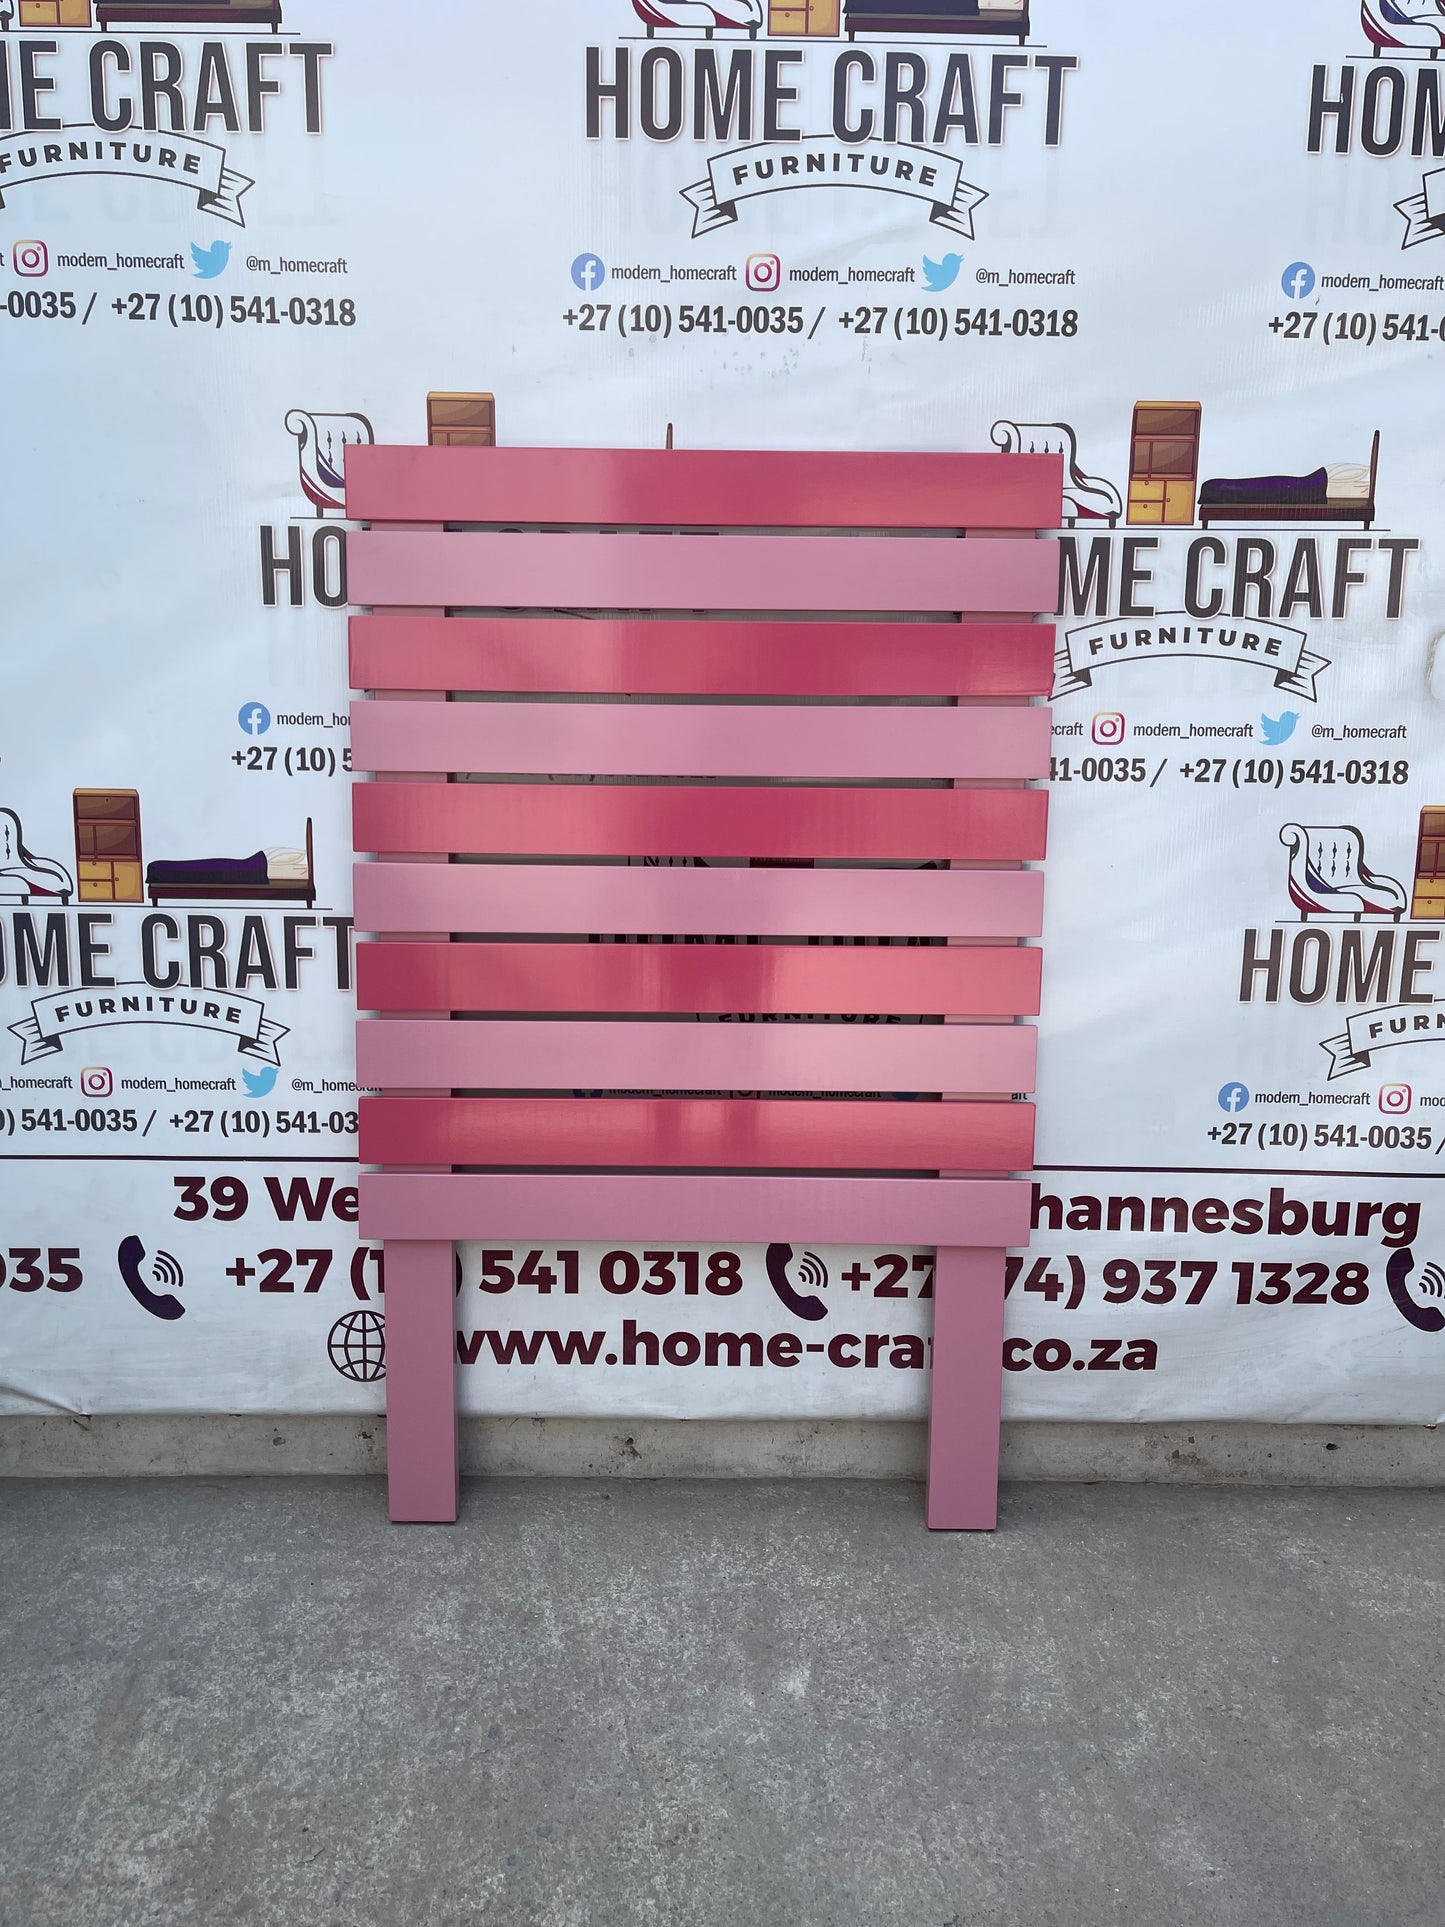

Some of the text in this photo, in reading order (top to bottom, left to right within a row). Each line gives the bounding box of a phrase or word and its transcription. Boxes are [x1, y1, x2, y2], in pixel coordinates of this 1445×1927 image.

[0, 40, 333, 133] E CRAFT
[585, 45, 1077, 146] HOME CRAFT
[0, 141, 201, 174] FURNITURE
[732, 152, 938, 187] FURNITURE
[57, 252, 348, 275] modern_homecraft @m_homecraft
[611, 264, 737, 283] modern_homecraft
[789, 266, 916, 285] modern_homecraft
[975, 268, 1076, 287] @m_homecraft
[1321, 273, 1445, 292] modern_homecraft
[111, 292, 161, 321] +27
[168, 293, 224, 329] (10)
[230, 295, 357, 327] 541-0318
[562, 303, 612, 331] +27
[618, 304, 672, 339] (10)
[678, 304, 804, 334] 541-0035
[838, 306, 888, 334] +27
[893, 307, 948, 342] (10)
[954, 308, 1079, 338] 541-0318
[1268, 311, 1318, 339] +27
[1323, 312, 1377, 347] (10)
[1184, 536, 1420, 619] CRAFT
[1088, 626, 1283, 656] FURNITURE
[1133, 723, 1408, 741] modern_homecraft @m_homecraft
[231, 746, 278, 771] +27
[284, 746, 336, 778] (10)
[1179, 758, 1227, 783] +27
[1232, 758, 1284, 789] (10)
[1289, 759, 1409, 785] 541-0318
[0, 911, 354, 990] ME CRAFT
[1239, 928, 1441, 1005] HOME
[54, 995, 243, 1024] FURNITURE
[121, 1076, 237, 1093] modern_homecraft
[291, 1078, 382, 1094] @m_home
[1254, 1090, 1371, 1107] modern_homecraft
[21, 1108, 138, 1132] 541-0035
[169, 1109, 214, 1133] +27
[220, 1110, 270, 1139] (10)
[1207, 1122, 1253, 1145] +27
[1257, 1123, 1308, 1152] (10)
[1313, 1124, 1432, 1150] 541-0035
[173, 1175, 249, 1222] 39
[0, 1247, 83, 1293] 35
[225, 1248, 333, 1294] +27
[478, 1249, 579, 1295] 541
[599, 1250, 743, 1296] 0318
[1102, 1258, 1218, 1305] 937
[1231, 1261, 1370, 1306] 1328
